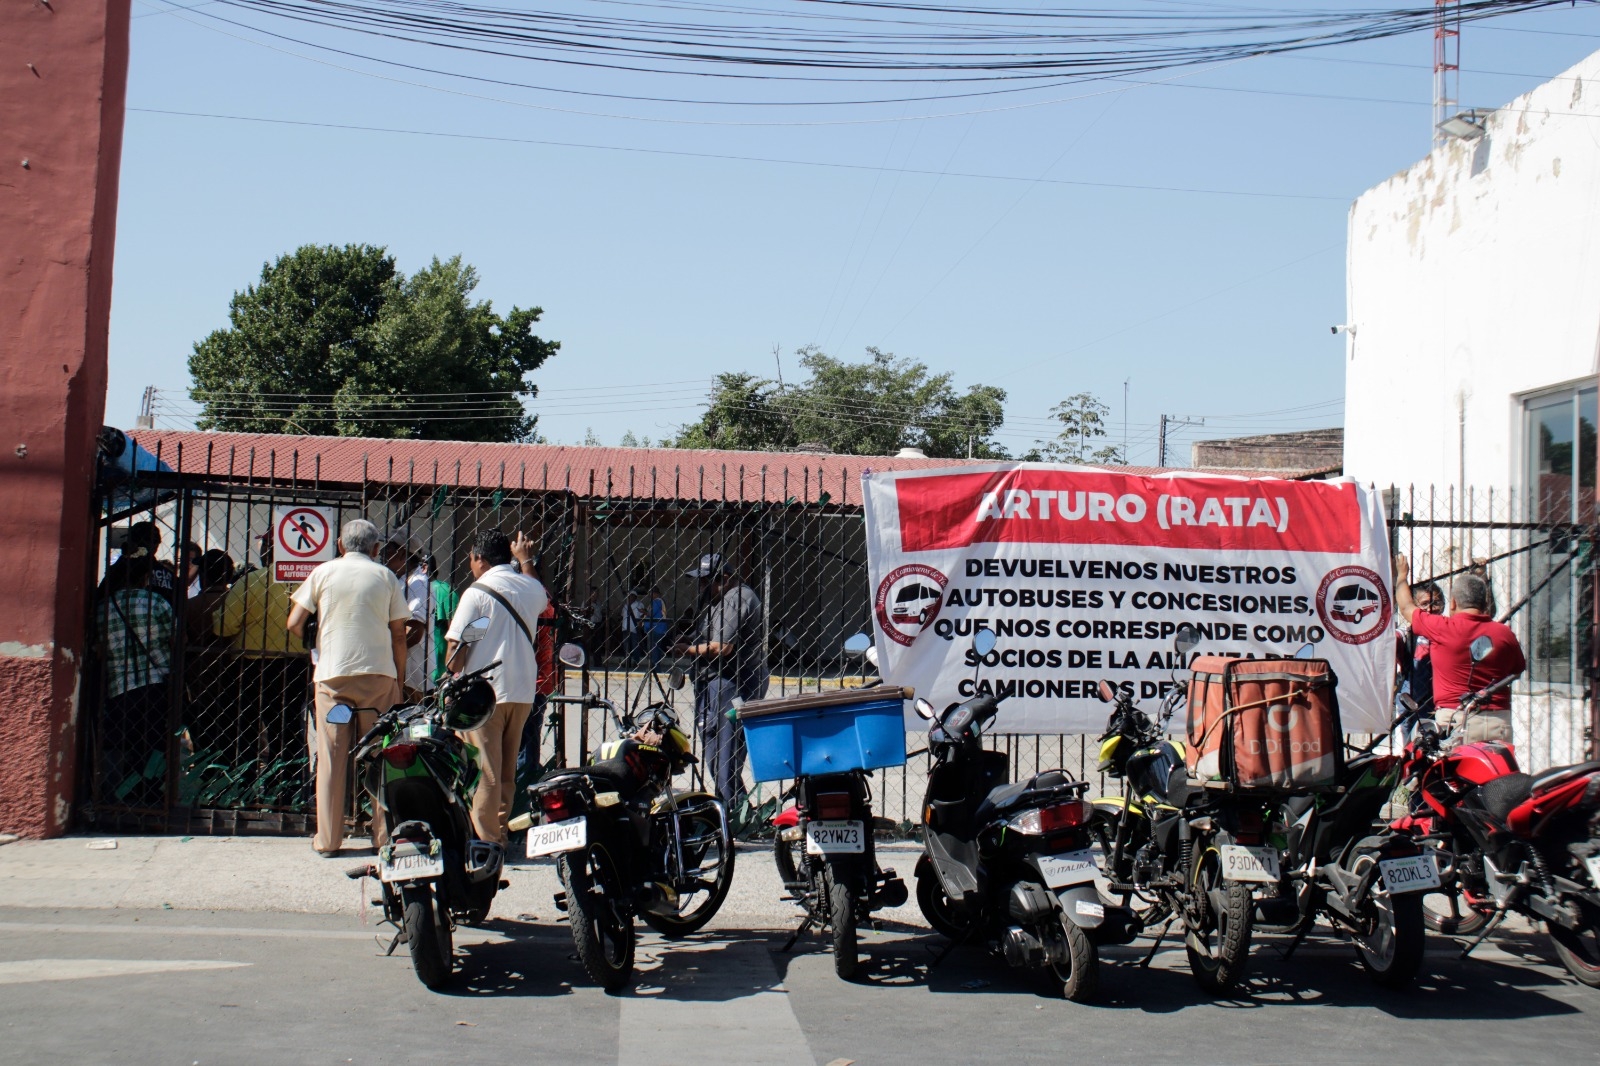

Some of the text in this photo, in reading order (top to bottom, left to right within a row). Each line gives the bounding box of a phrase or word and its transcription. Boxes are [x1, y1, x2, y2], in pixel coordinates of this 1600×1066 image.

[975, 489, 1289, 532] ARTURO (RATA)
[966, 559, 1297, 584] DEVUELVENOS NUESTROS
[945, 588, 1314, 616] AUTOBUSES Y CONCESIONES,
[934, 618, 989, 641] QUE
[996, 618, 1051, 637] NOS
[1253, 624, 1325, 643] COMO
[964, 649, 1063, 667] SOCIOS
[1068, 650, 1102, 668] DE
[1109, 650, 1141, 668] LA
[533, 825, 579, 847] 78DKY4
[813, 829, 858, 844] 82YWZ3
[1057, 861, 1092, 874] ITALIKA
[1229, 855, 1272, 871] 93DKX1
[1388, 864, 1432, 883] 82DKL3
